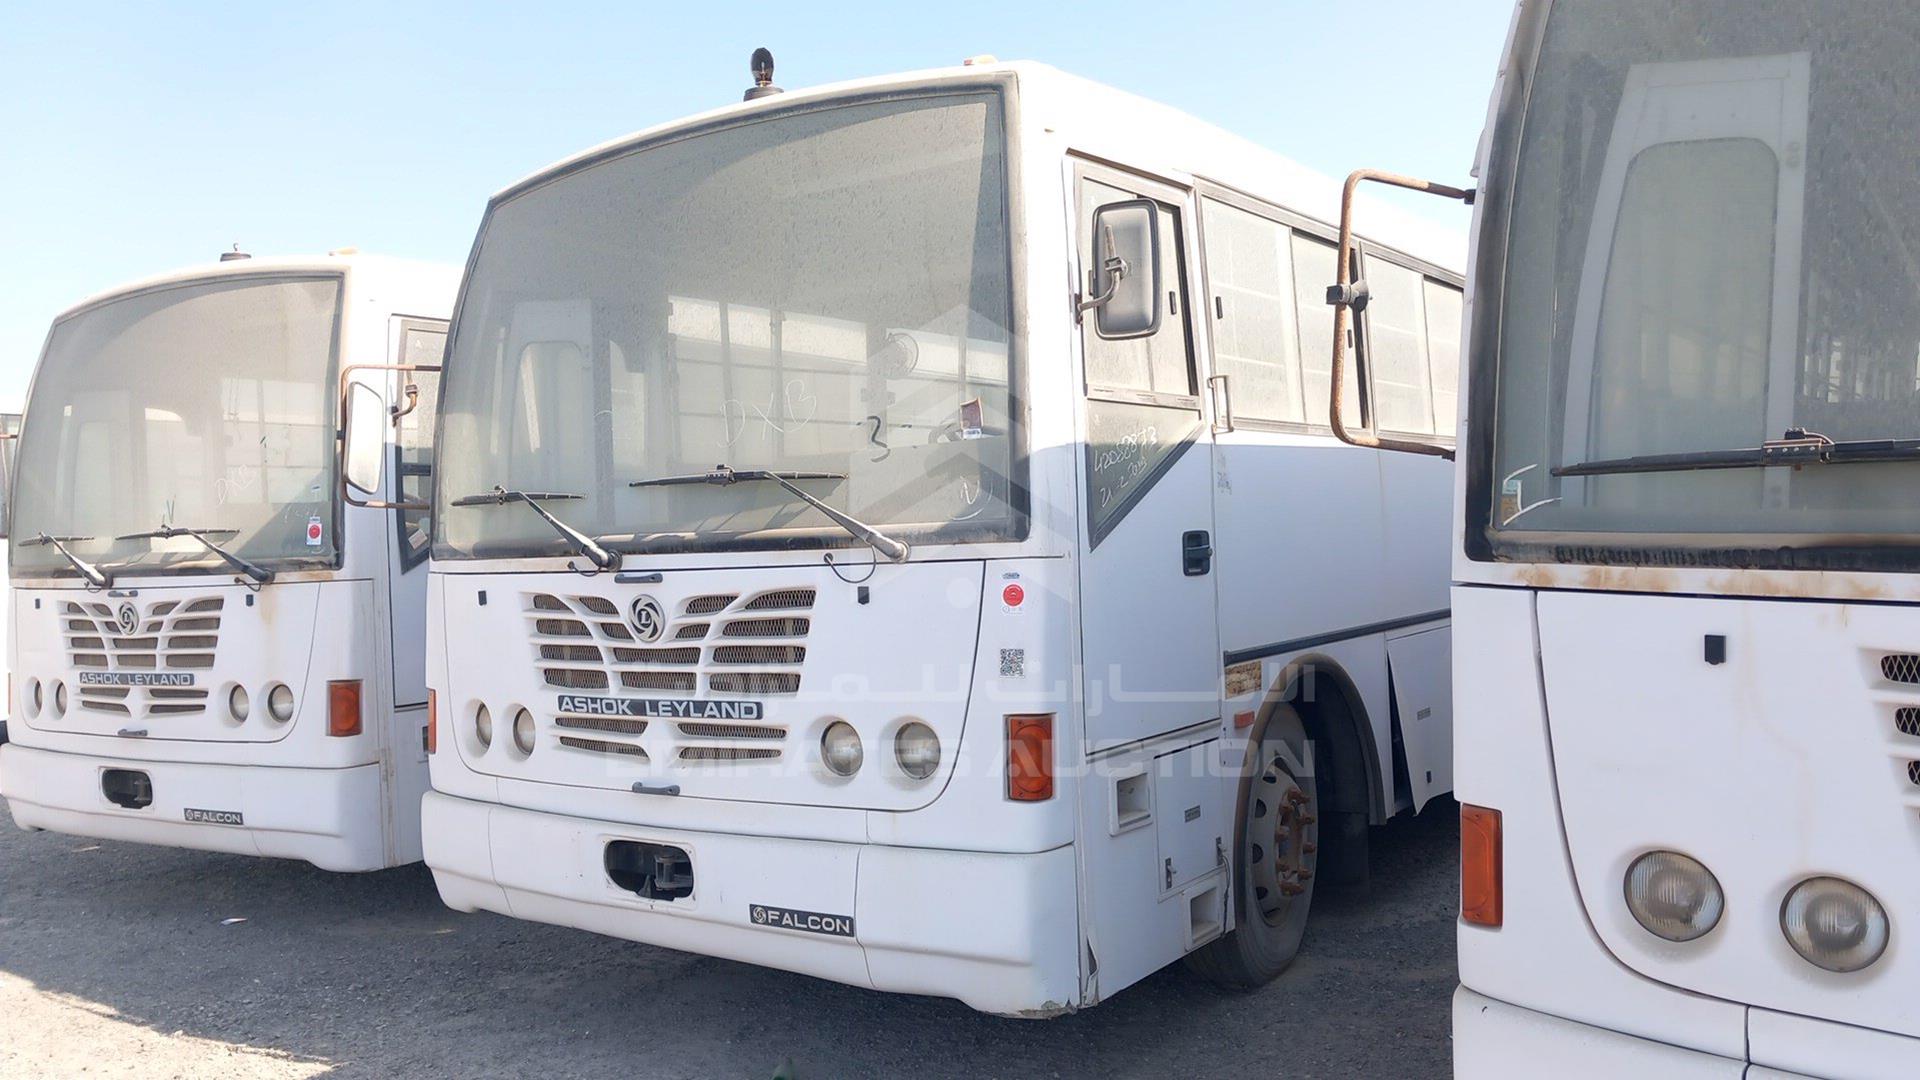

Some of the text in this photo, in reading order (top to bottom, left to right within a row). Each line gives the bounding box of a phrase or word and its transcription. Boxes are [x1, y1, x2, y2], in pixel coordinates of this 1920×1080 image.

[80, 673, 191, 686] ASHOK LEYLAND
[560, 696, 759, 720] ASHOK LEYLAND
[194, 811, 242, 824] FALCON
[767, 910, 850, 934] FALCON
